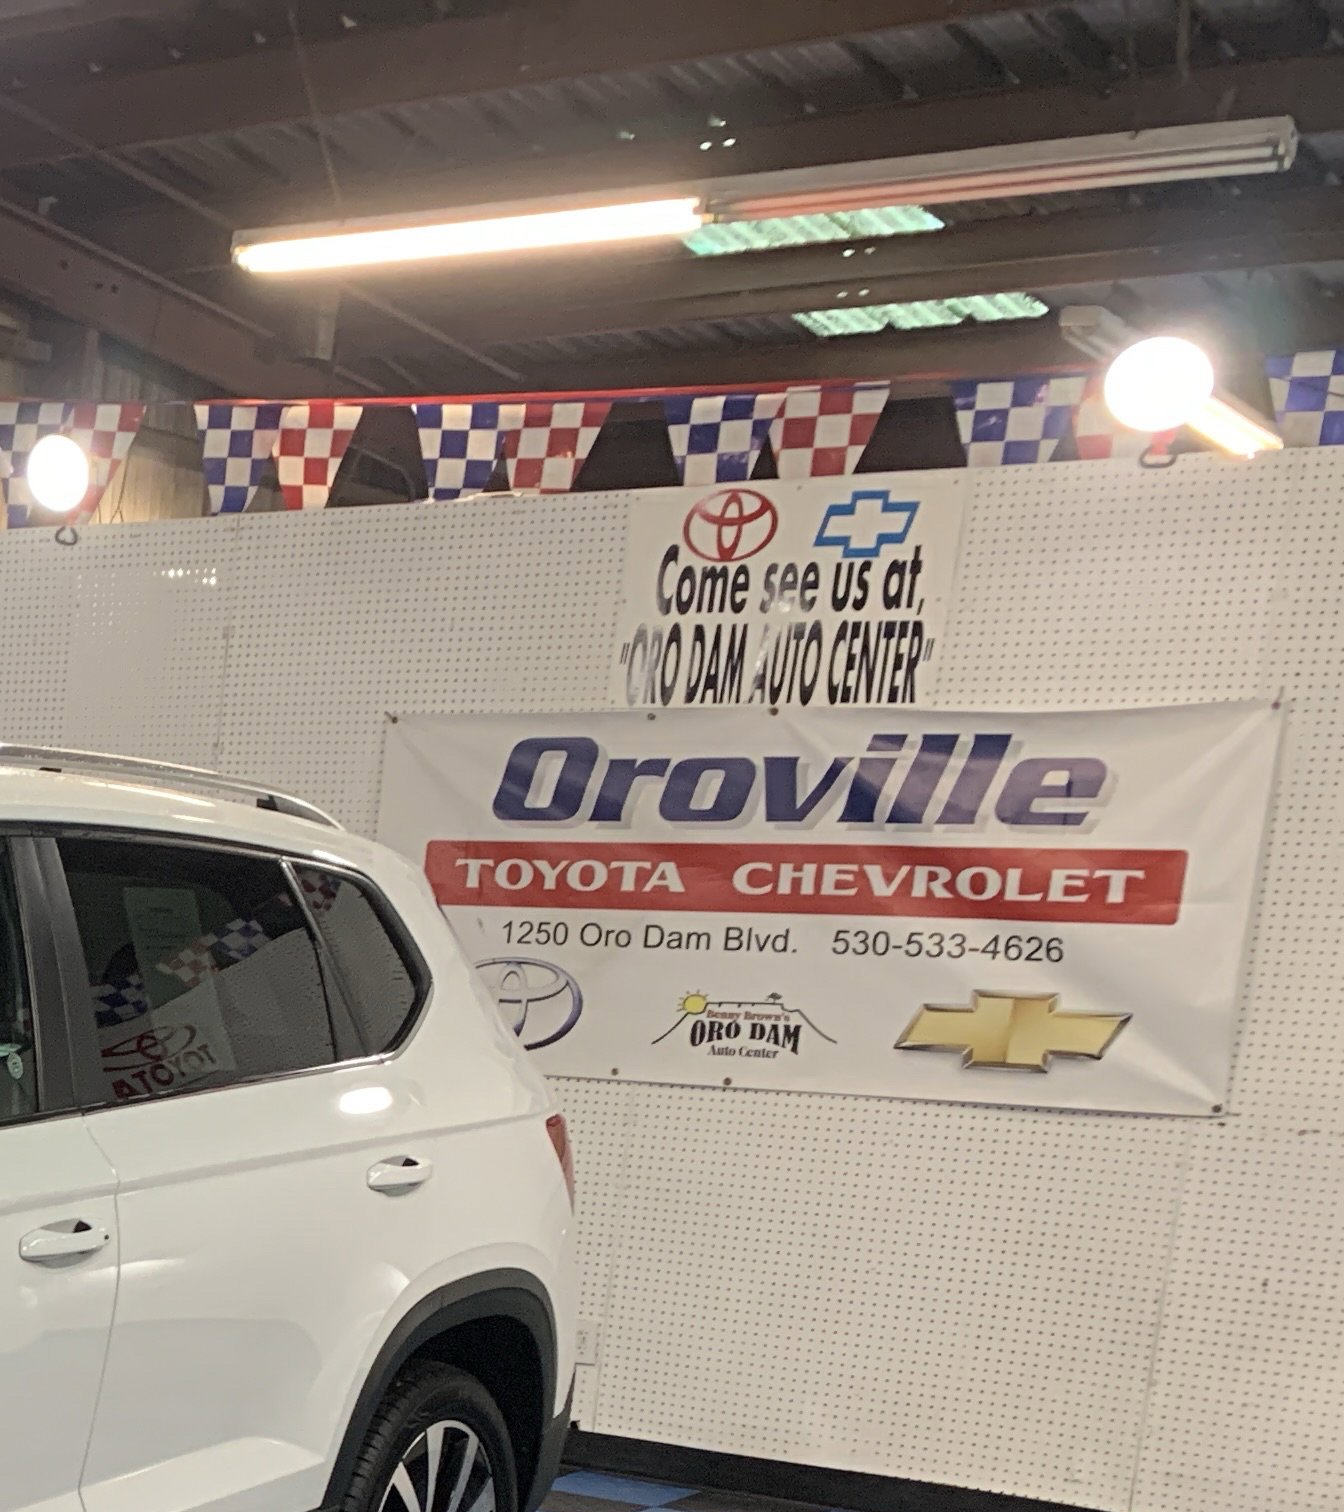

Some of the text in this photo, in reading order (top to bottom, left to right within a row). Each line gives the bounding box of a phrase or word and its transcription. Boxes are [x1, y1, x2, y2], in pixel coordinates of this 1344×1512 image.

[657, 543, 925, 615] Come see us at,
[619, 619, 936, 707] "ORO DAM AUTO CENTER"
[491, 732, 1112, 830] Oroville
[454, 857, 1145, 905] TOYOTA CHEVROLET
[501, 919, 1065, 964] 1250 Oro Dam Blvd. 530-533-4626
[690, 1019, 802, 1055] ORO DAM
[743, 1011, 790, 1022] Brown's
[708, 1044, 779, 1059] Auto Center
